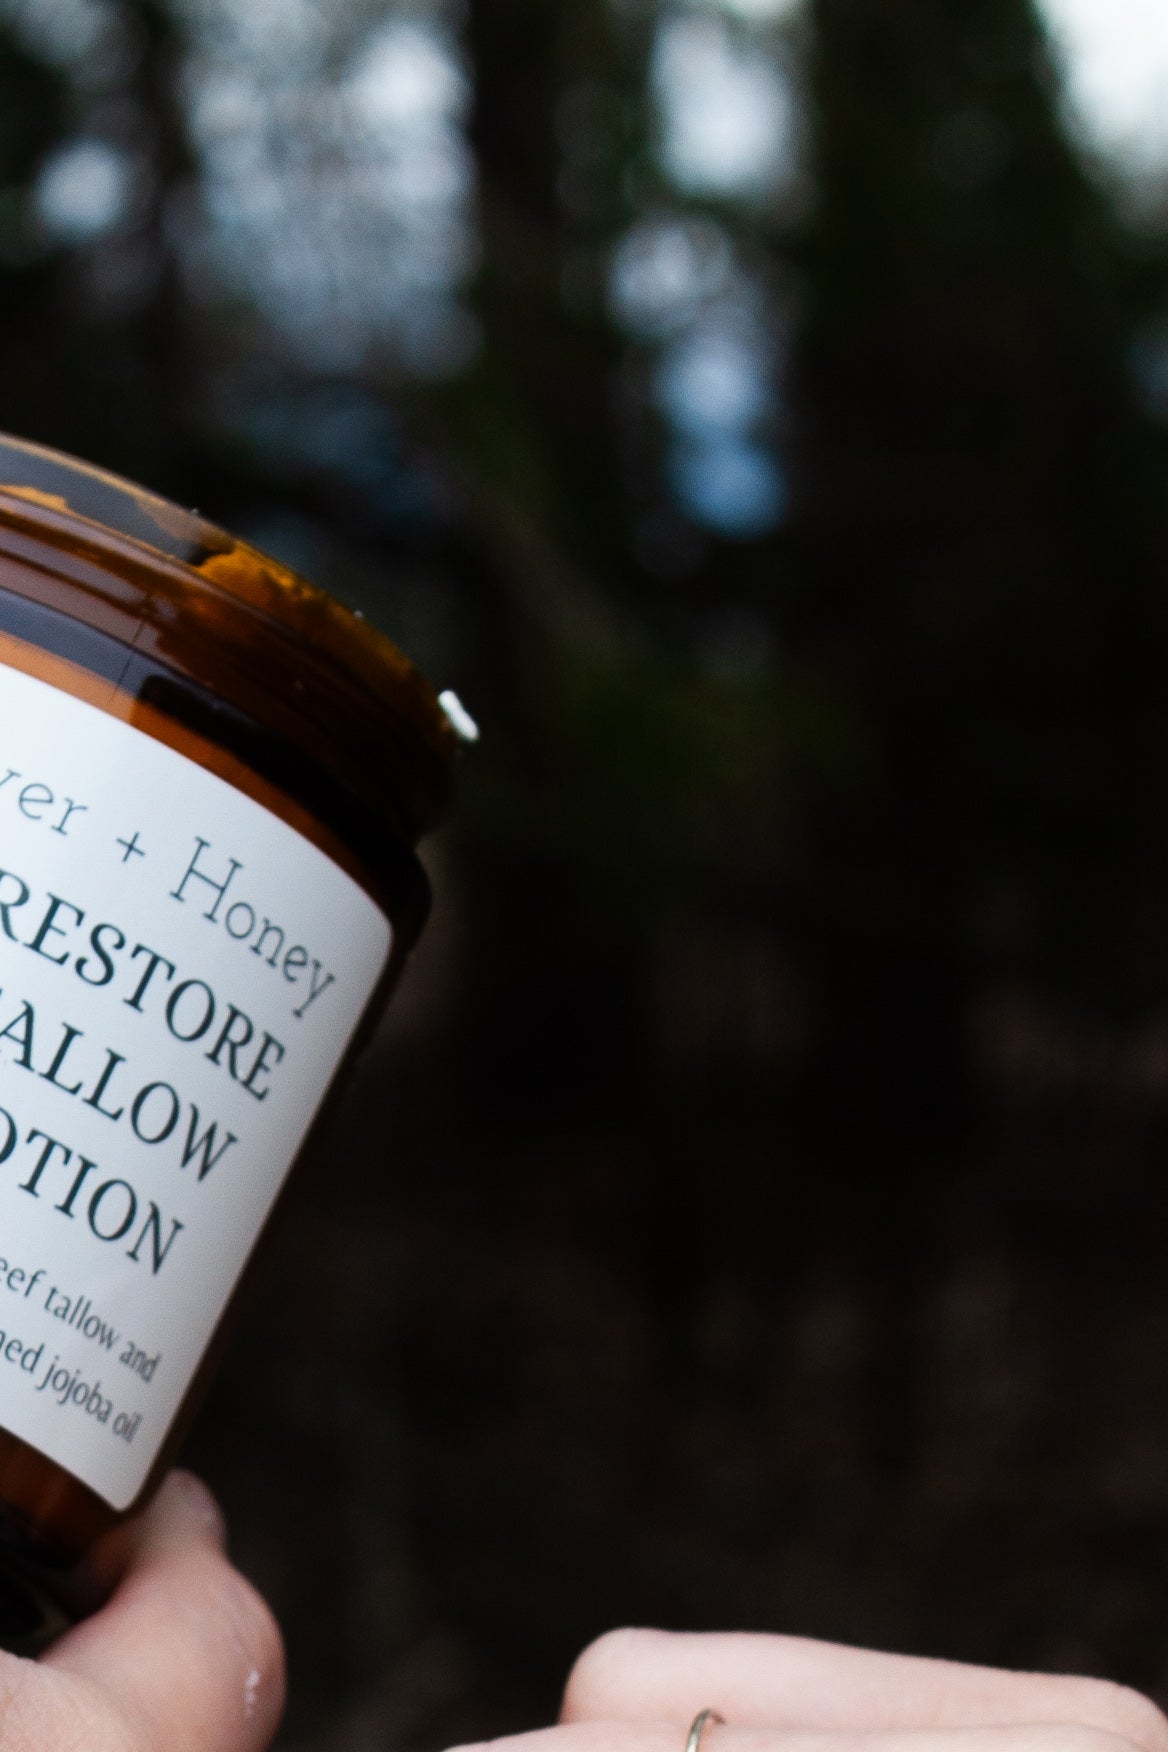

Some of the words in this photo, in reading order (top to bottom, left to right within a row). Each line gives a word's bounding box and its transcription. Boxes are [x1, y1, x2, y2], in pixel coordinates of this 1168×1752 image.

[116, 832, 145, 862] +
[169, 836, 335, 1018] Honey
[43, 1286, 120, 1350] tallow
[119, 1341, 161, 1383] and
[36, 1355, 113, 1423] jojoba
[113, 1412, 142, 1443] oil
